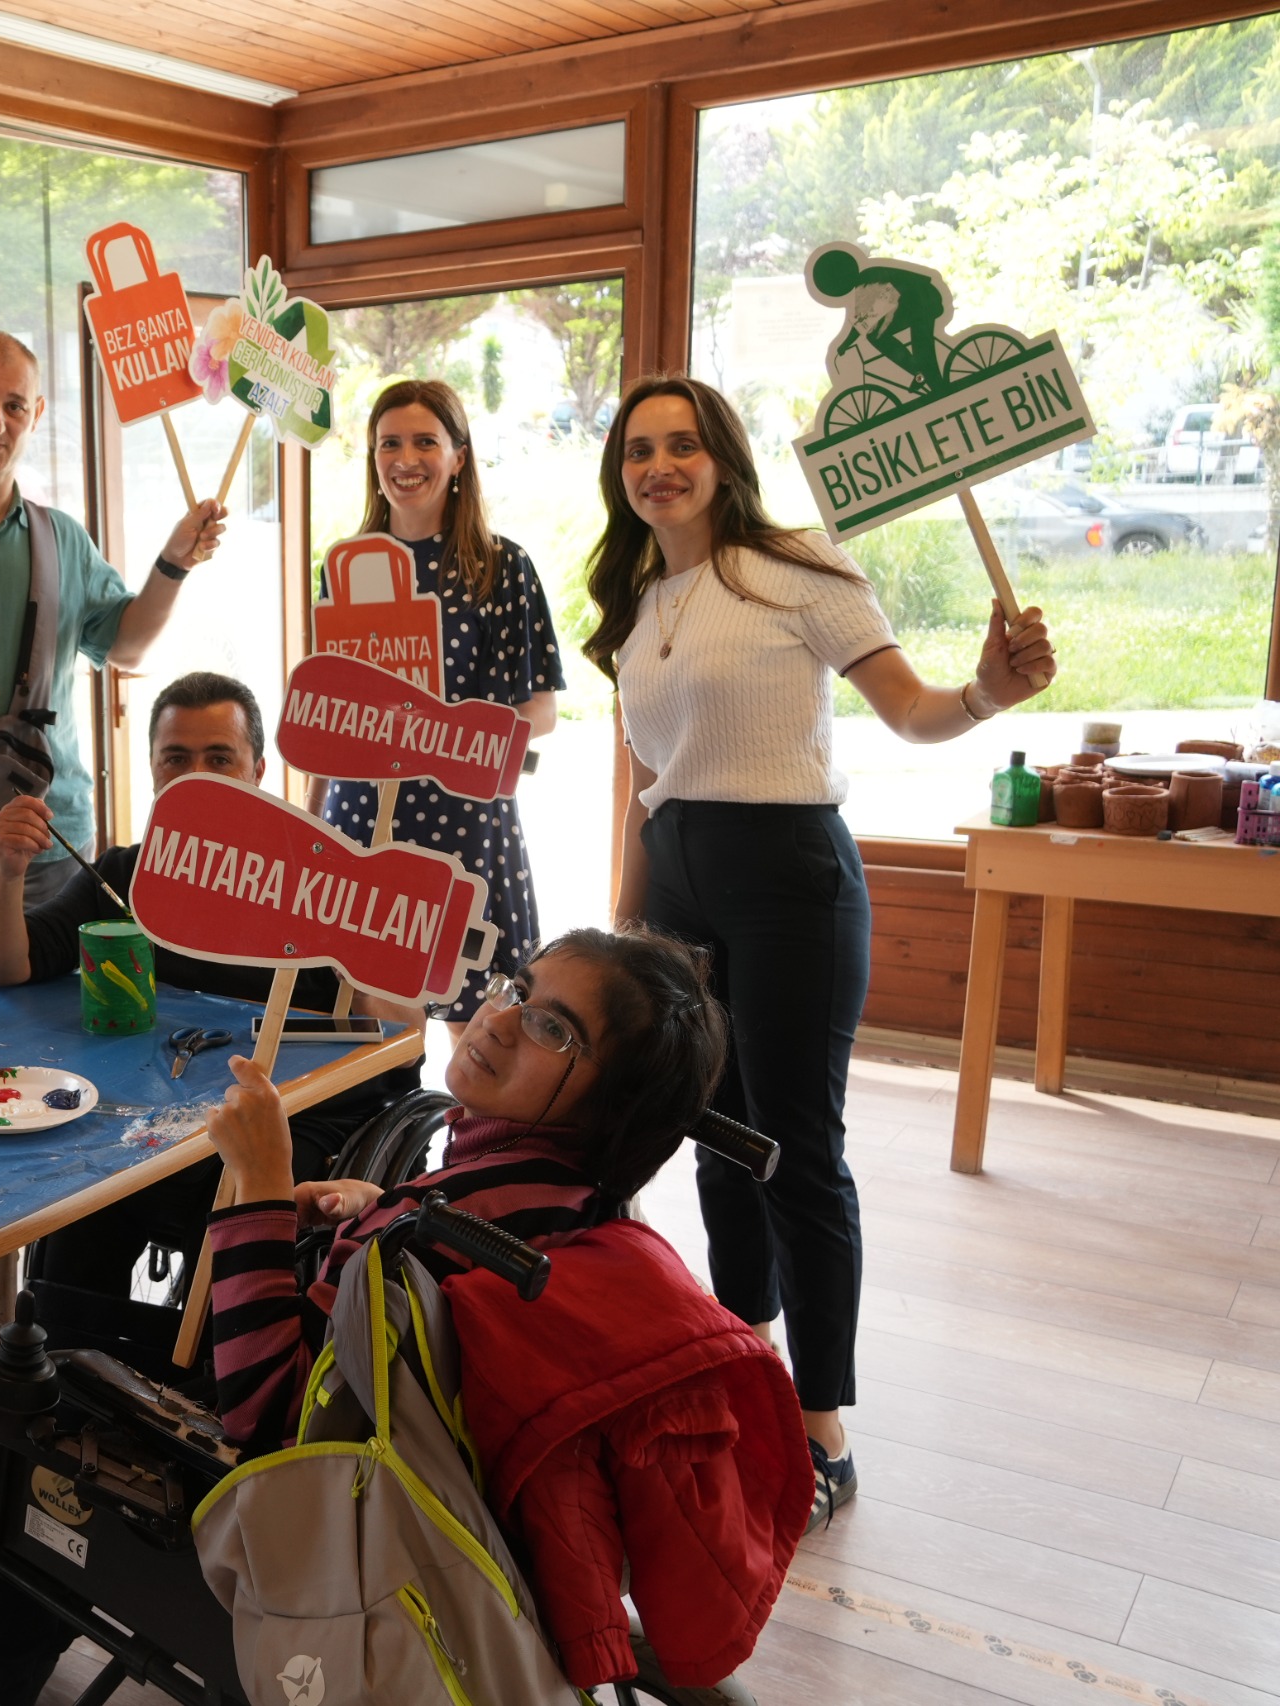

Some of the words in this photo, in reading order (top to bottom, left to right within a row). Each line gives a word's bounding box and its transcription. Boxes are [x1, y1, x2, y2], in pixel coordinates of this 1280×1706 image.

[103, 324, 136, 354] BEZ
[136, 308, 188, 347] ÇANTA
[111, 336, 191, 391] KULLAN
[238, 313, 288, 360] YENİDEN
[289, 343, 336, 390] KULLAN
[231, 339, 265, 372] GERİ
[263, 358, 324, 414] DÖNÜŞTÜR
[248, 381, 290, 418] AZALT
[818, 397, 1005, 511] BİSİKLETE
[1001, 367, 1073, 432] BİN
[368, 636, 432, 666] ÇANTA
[285, 688, 394, 745] MATARA
[400, 714, 507, 770] KULLAN
[143, 825, 285, 910] MATARA
[291, 867, 441, 955] KULLAN
[39, 1487, 82, 1519] WOLLEX
